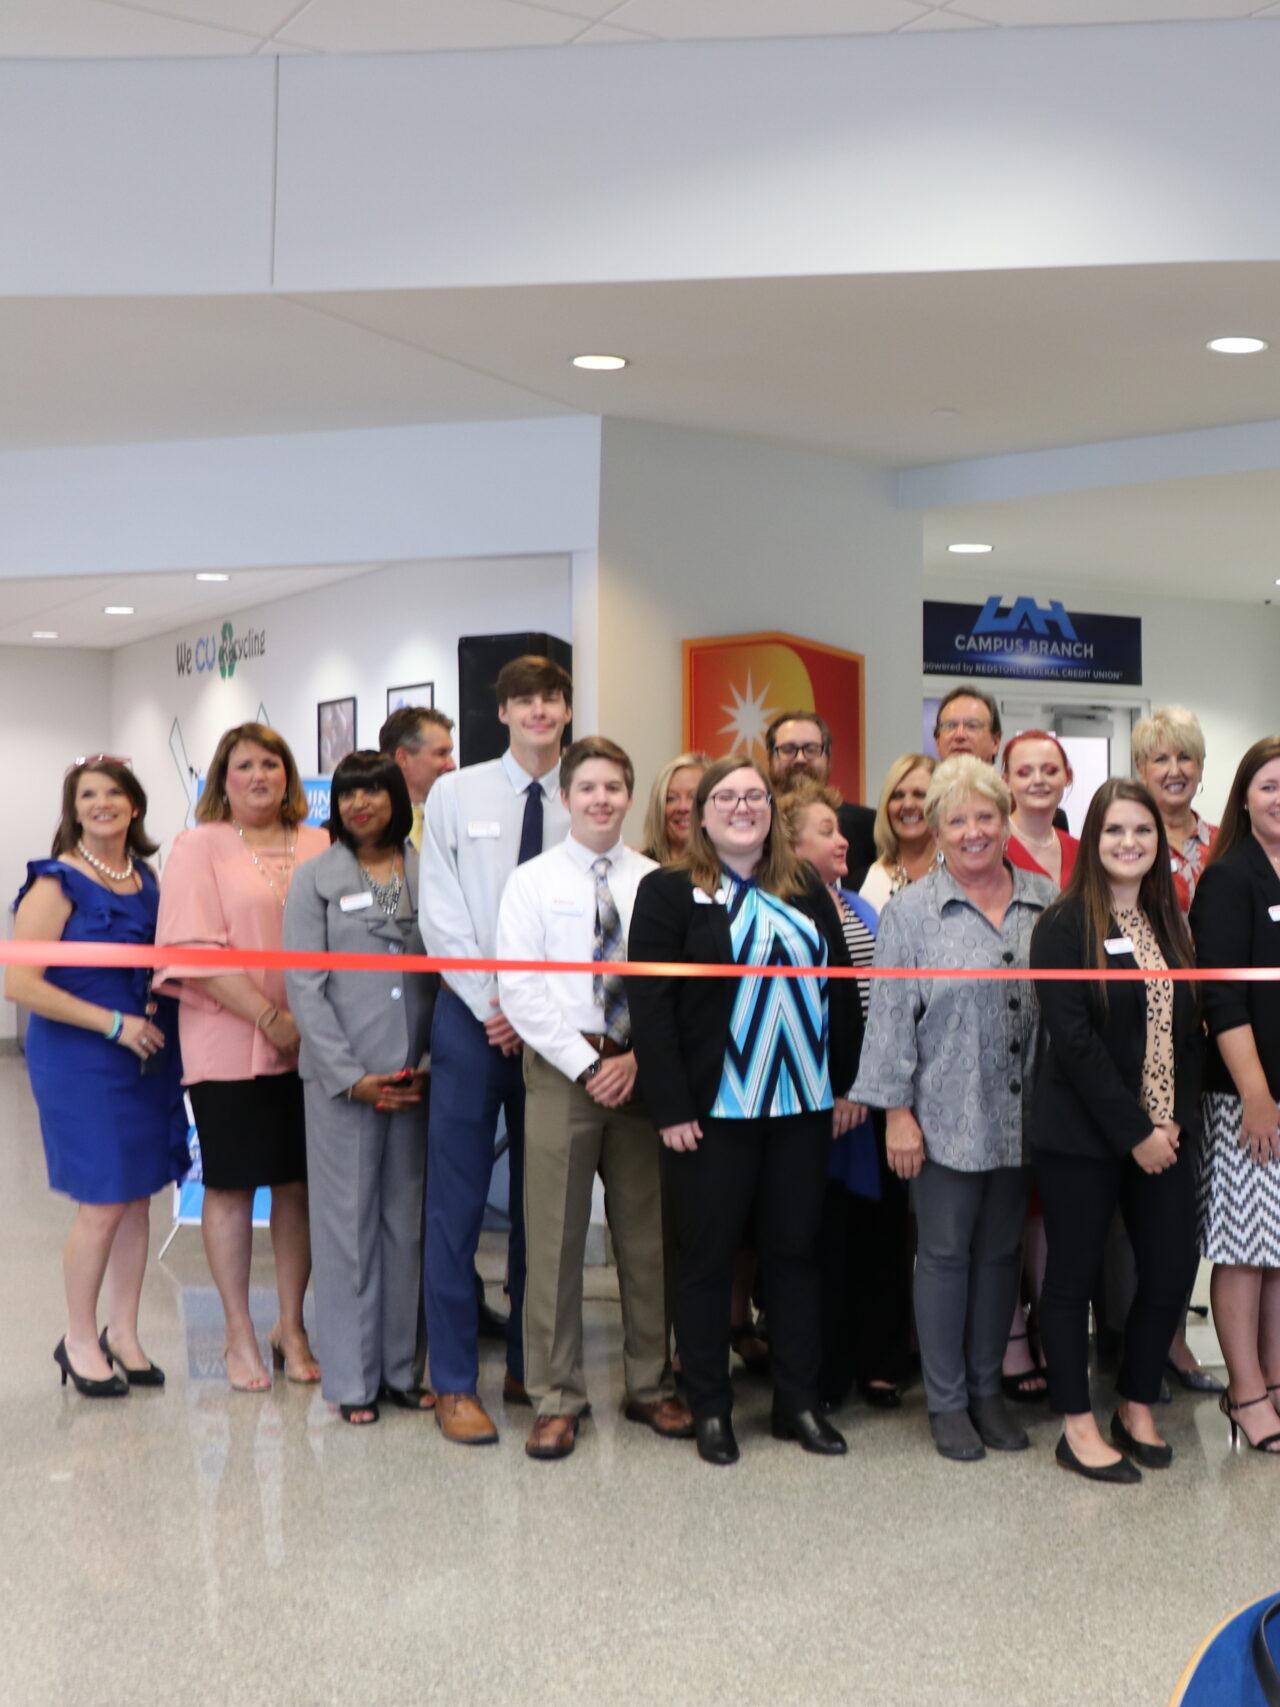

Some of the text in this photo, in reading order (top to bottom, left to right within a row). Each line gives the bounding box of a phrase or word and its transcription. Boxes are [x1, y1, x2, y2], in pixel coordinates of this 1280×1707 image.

[176, 640, 192, 677] We
[954, 633, 1094, 659] CAMPUS BRANCH
[962, 662, 974, 674] by
[1061, 669, 1091, 679] CREDIT
